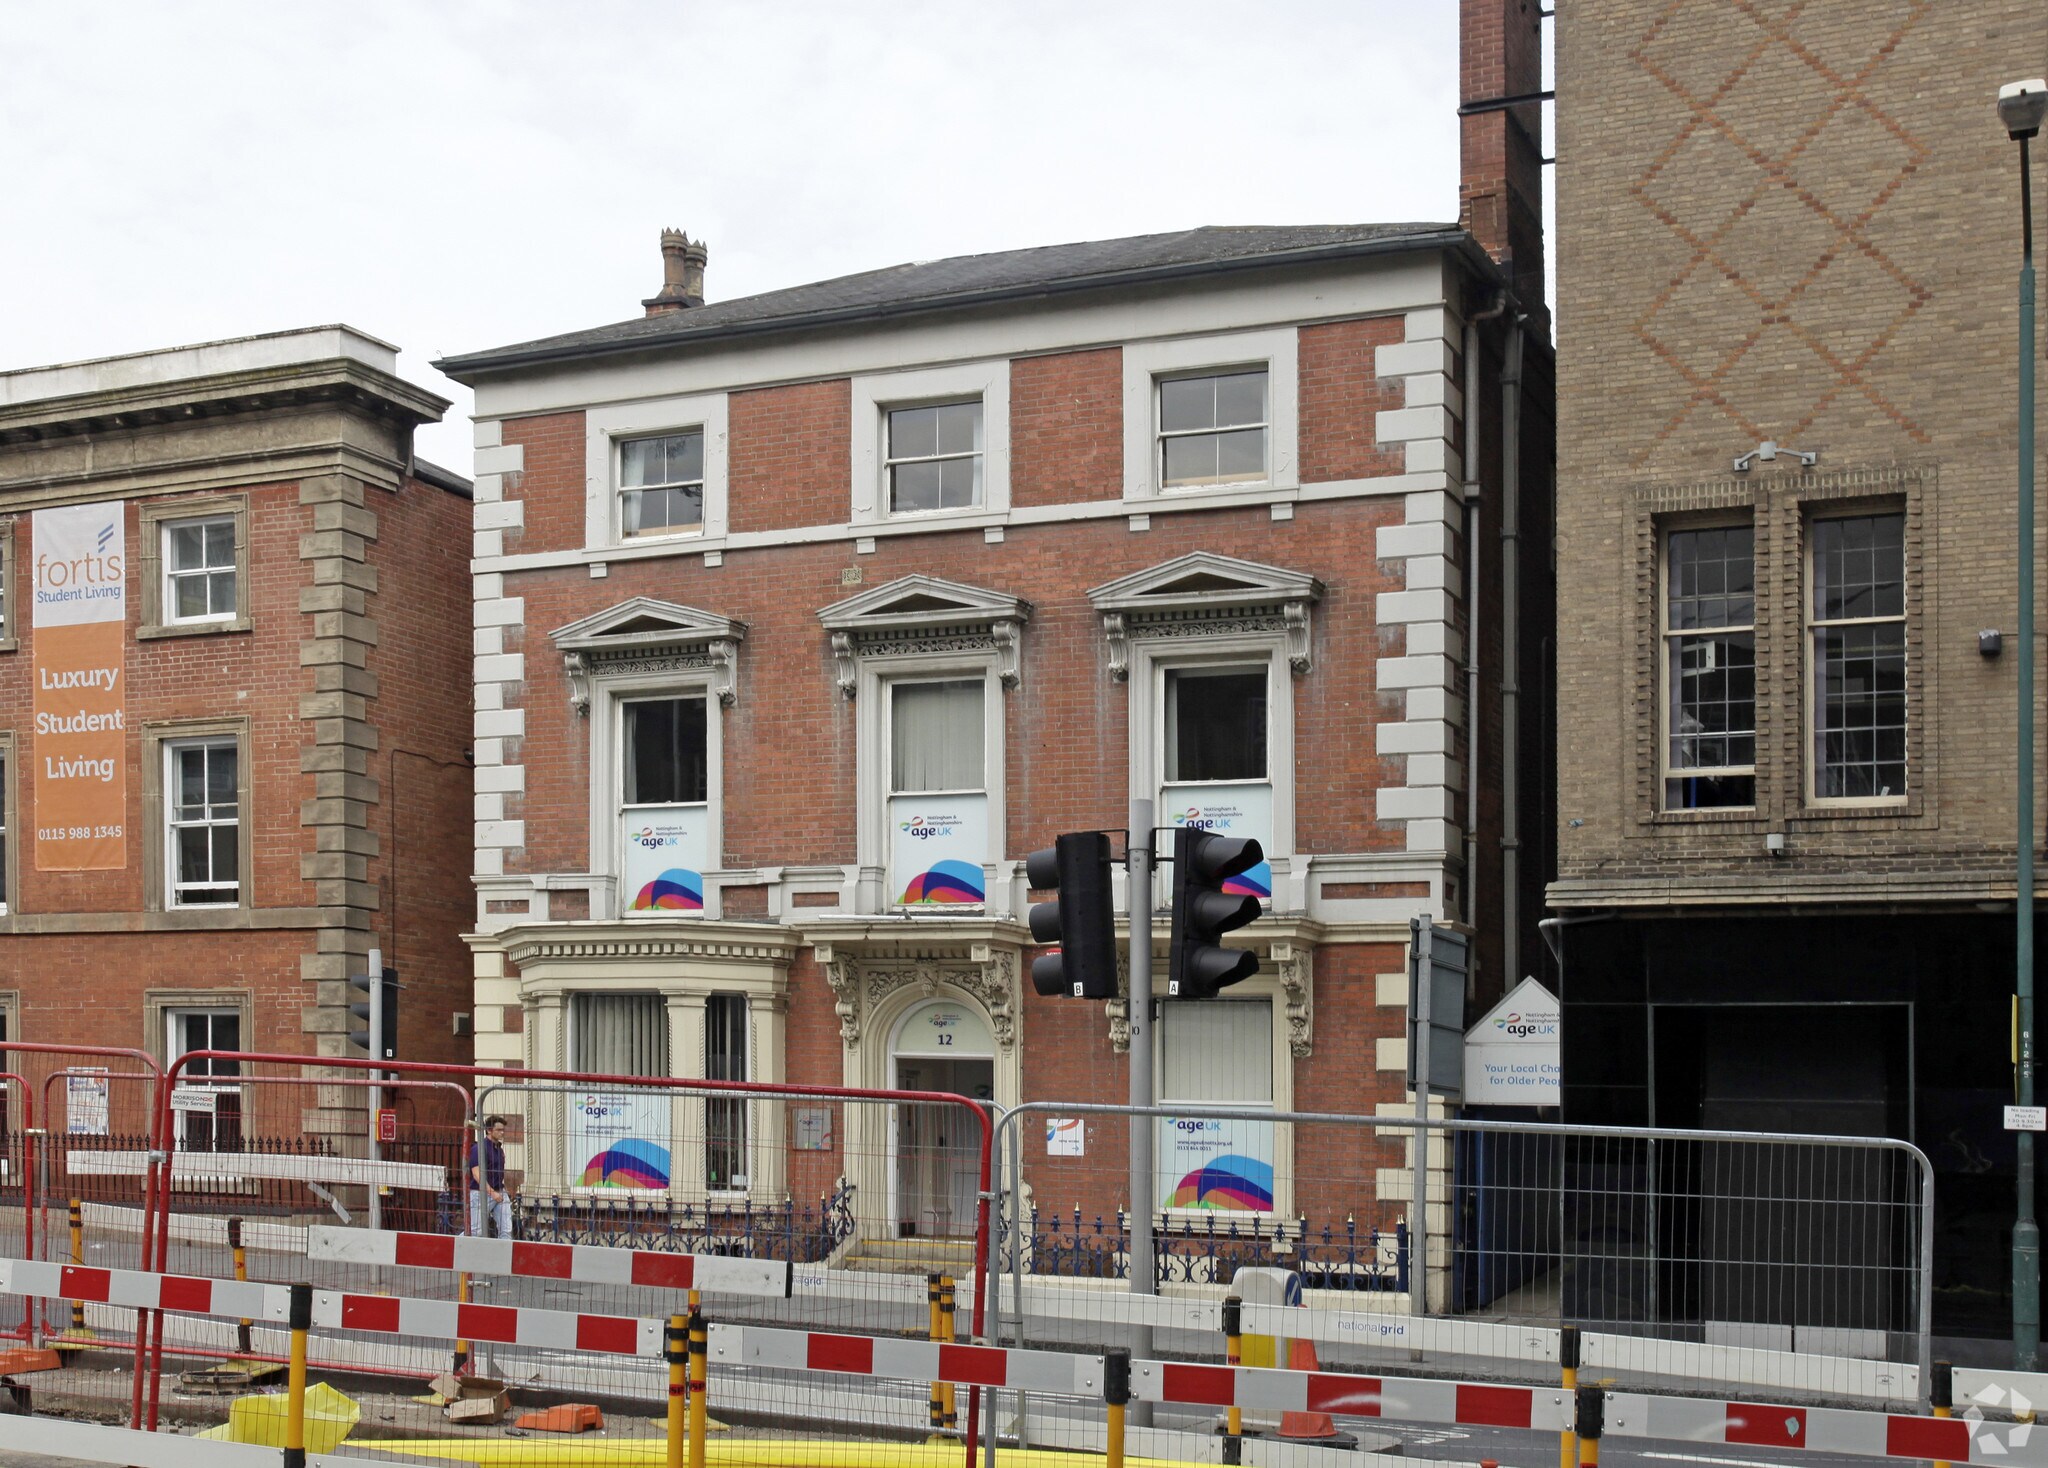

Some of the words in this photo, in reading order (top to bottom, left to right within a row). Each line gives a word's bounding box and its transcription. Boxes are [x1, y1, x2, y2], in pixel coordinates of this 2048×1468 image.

[37, 553, 122, 588] fortis
[37, 588, 82, 604] Student
[85, 584, 121, 603] Living
[40, 667, 118, 690] Luxury
[36, 708, 124, 735] Student
[45, 755, 115, 782] Living
[1186, 818, 1213, 831] age
[1215, 819, 1231, 828] UK
[38, 827, 66, 841] 0115
[69, 826, 91, 840] 988
[94, 825, 122, 839] 1345
[911, 826, 936, 840] age
[938, 827, 952, 836] UK
[641, 836, 664, 850] age
[665, 837, 678, 846] UK
[1507, 1024, 1536, 1038] age
[1538, 1025, 1555, 1034] UK
[938, 1034, 953, 1046] 12
[1485, 1064, 1508, 1073] Your
[1511, 1064, 1538, 1073] Local
[1490, 1075, 1504, 1085] for
[1507, 1075, 1535, 1085] Older
[586, 1106, 608, 1119] age
[609, 1107, 622, 1116] UK
[1177, 1120, 1204, 1133] age
[1205, 1121, 1221, 1131] UK
[1338, 1319, 1404, 1335] nationalgrid
